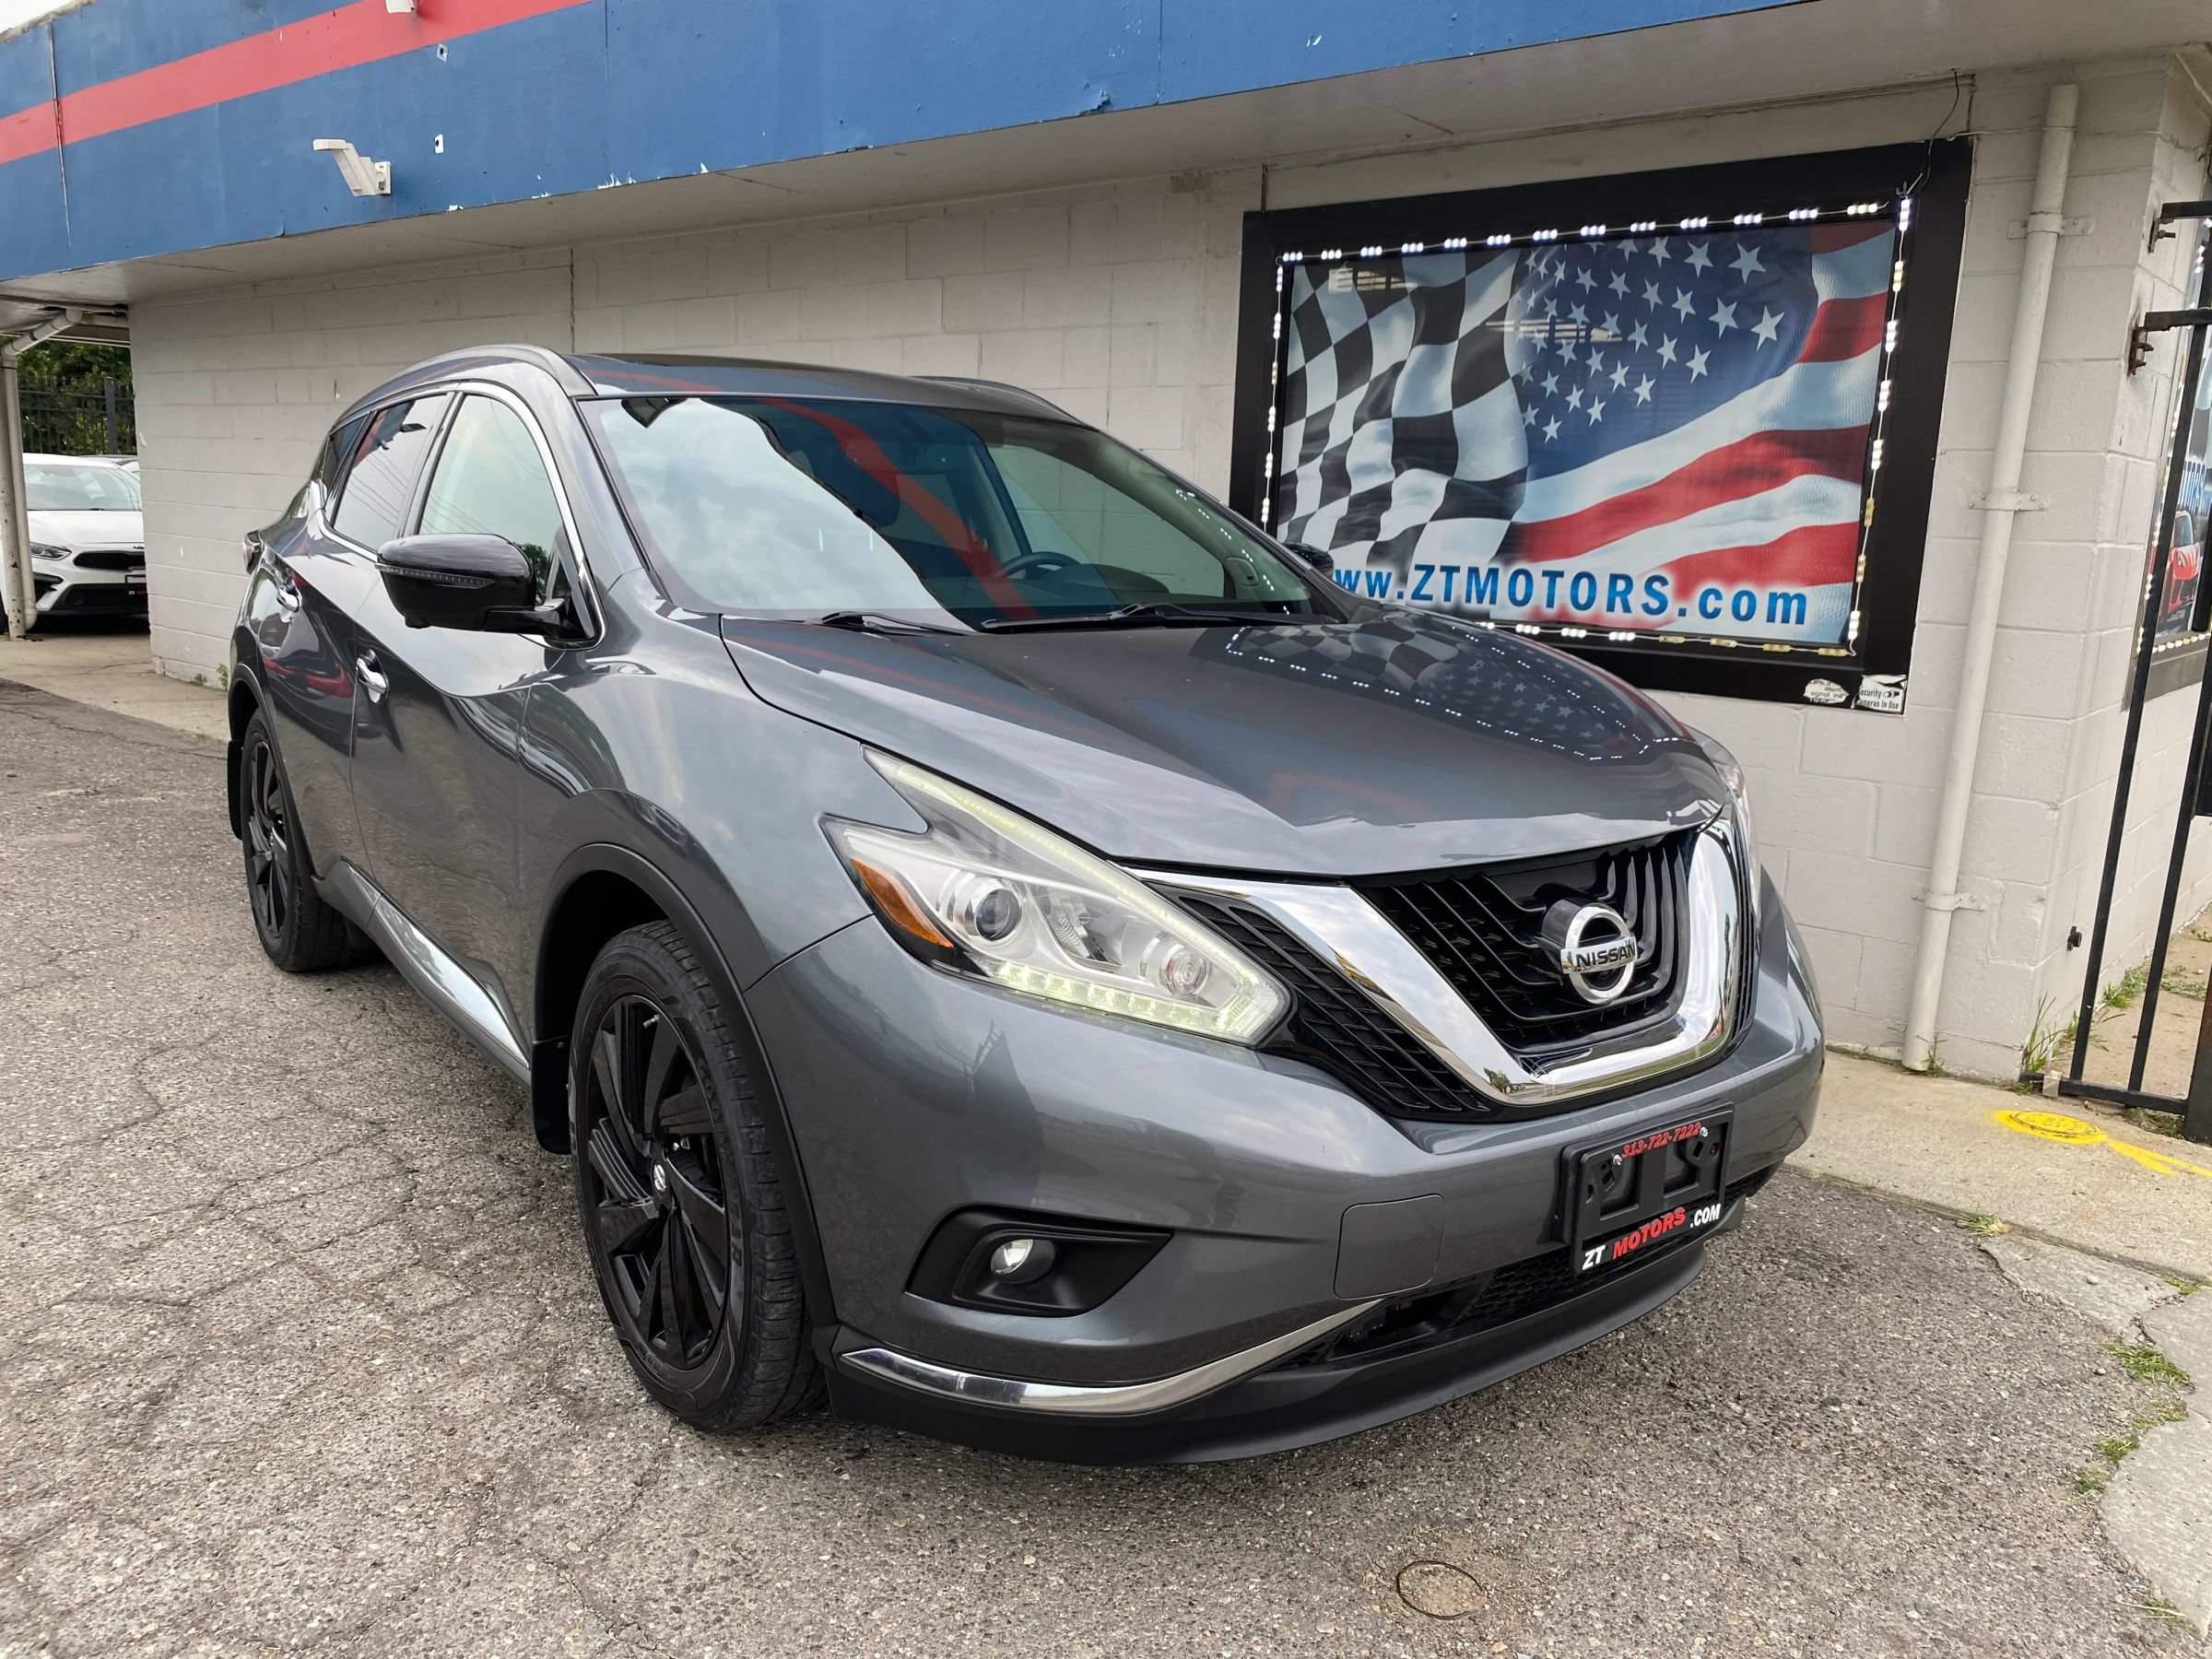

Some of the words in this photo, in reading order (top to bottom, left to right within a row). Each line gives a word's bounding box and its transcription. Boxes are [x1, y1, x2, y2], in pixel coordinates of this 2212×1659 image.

[1334, 563, 1807, 626] ww.ZTMOTORS.com
[1856, 700, 1880, 708] ameras
[1859, 688, 1881, 700] ecurity
[1575, 942, 1636, 968] NISSAN
[1582, 1245, 1606, 1270] ZT
[1613, 1206, 1688, 1259] MOTORS
[1689, 1203, 1722, 1228] .COM
